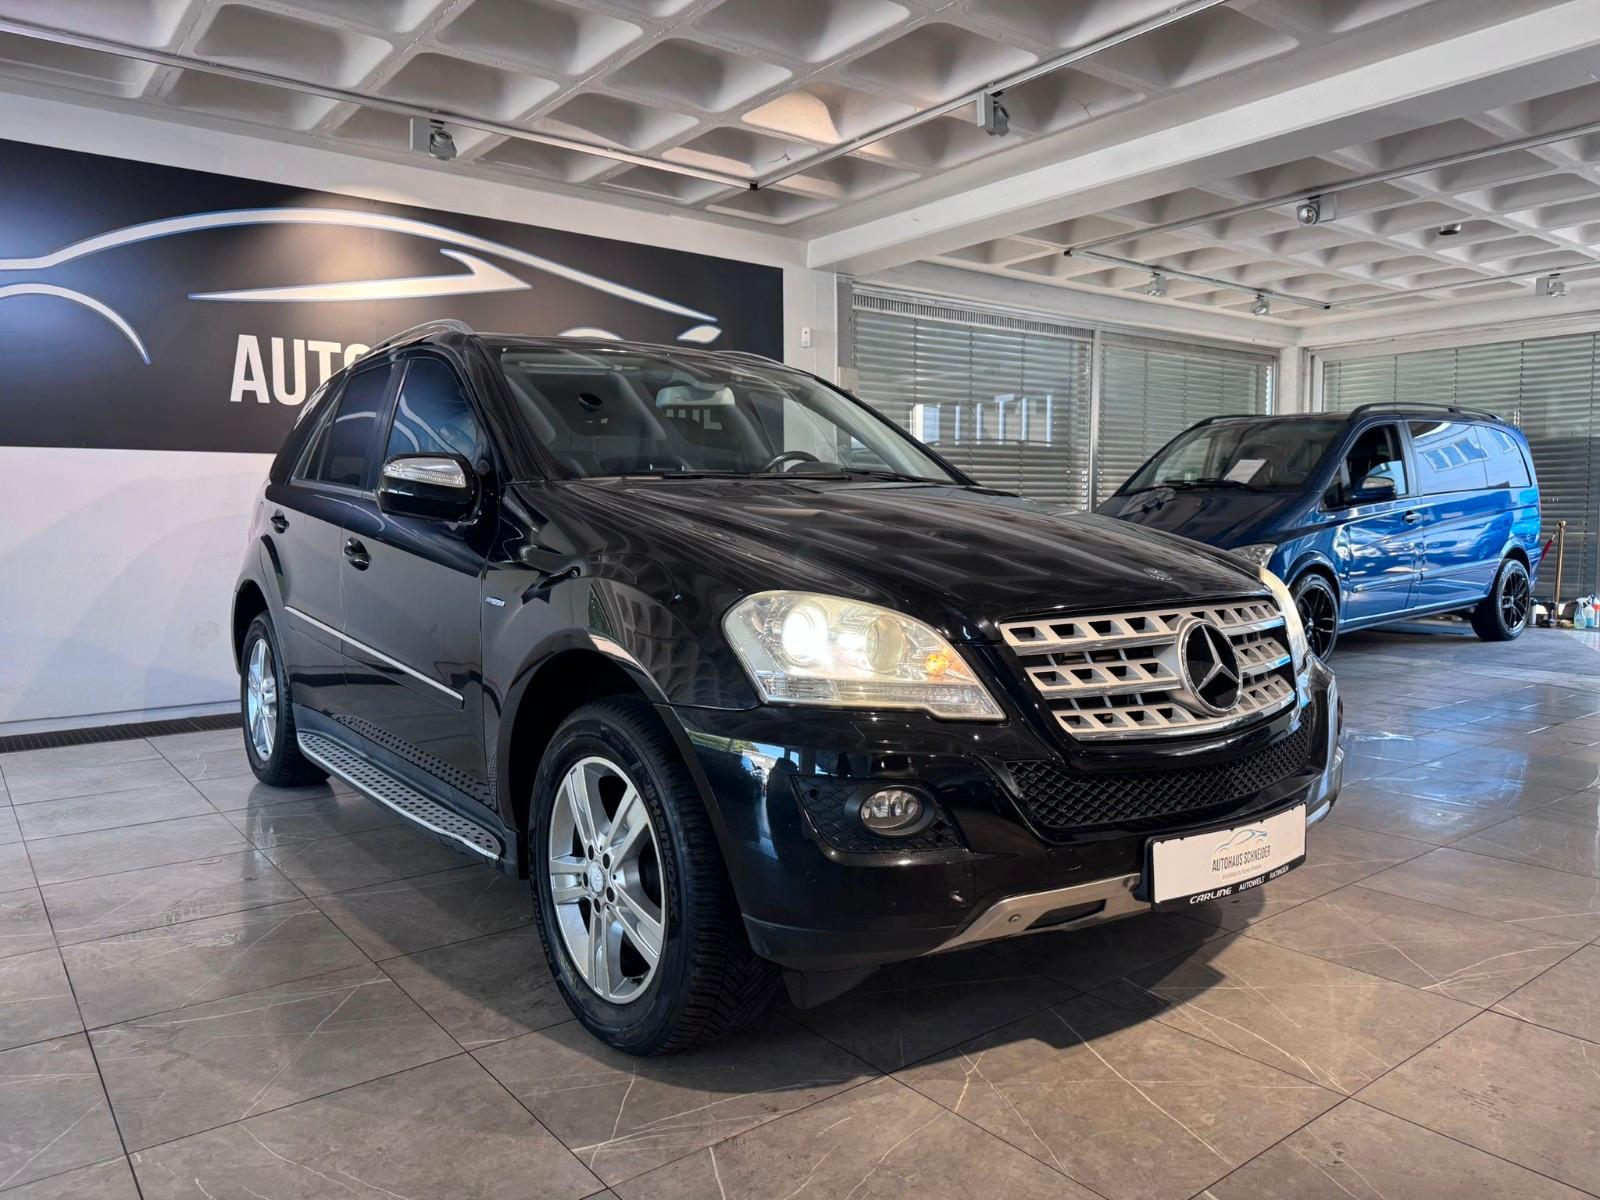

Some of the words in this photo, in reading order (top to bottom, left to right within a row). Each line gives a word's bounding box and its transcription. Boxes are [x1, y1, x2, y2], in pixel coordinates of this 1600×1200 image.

[1212, 852, 1243, 873] AUTOHAUS
[1243, 845, 1271, 865] SCHNEIDER
[1189, 886, 1232, 905] CARLINE
[1238, 875, 1265, 892] AUTOWELT
